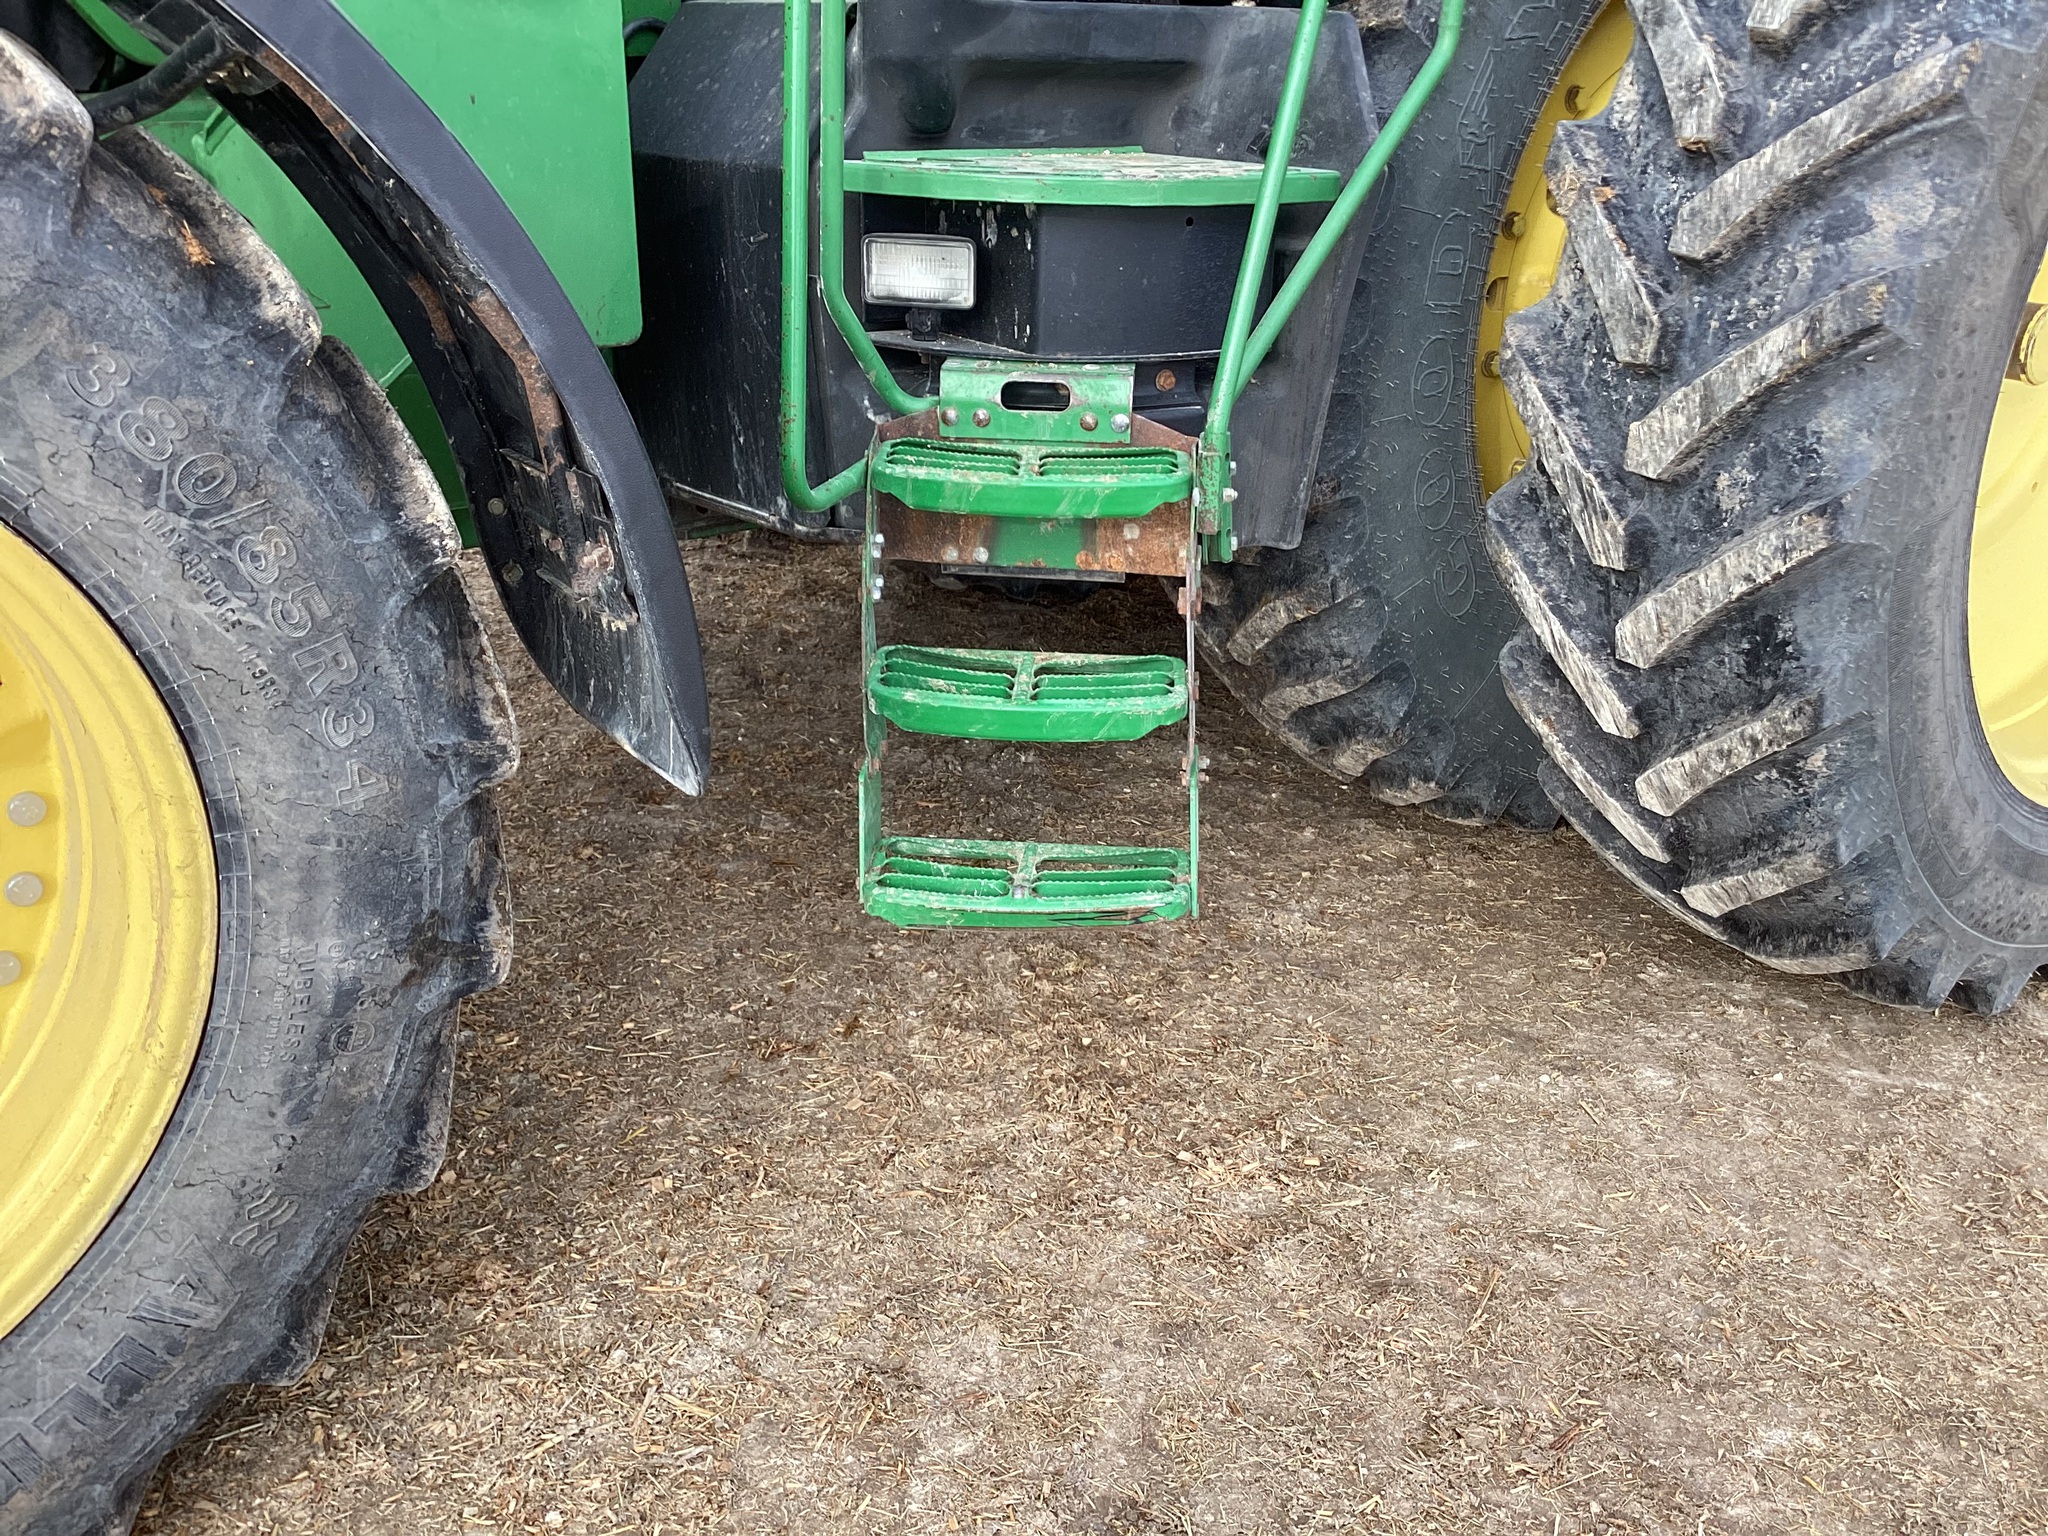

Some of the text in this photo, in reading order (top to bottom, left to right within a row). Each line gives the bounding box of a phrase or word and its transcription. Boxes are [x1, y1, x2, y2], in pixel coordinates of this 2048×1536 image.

[142, 510, 187, 549] MAY
[181, 553, 243, 633] REPLACE
[280, 942, 318, 1063] TUBELESS
